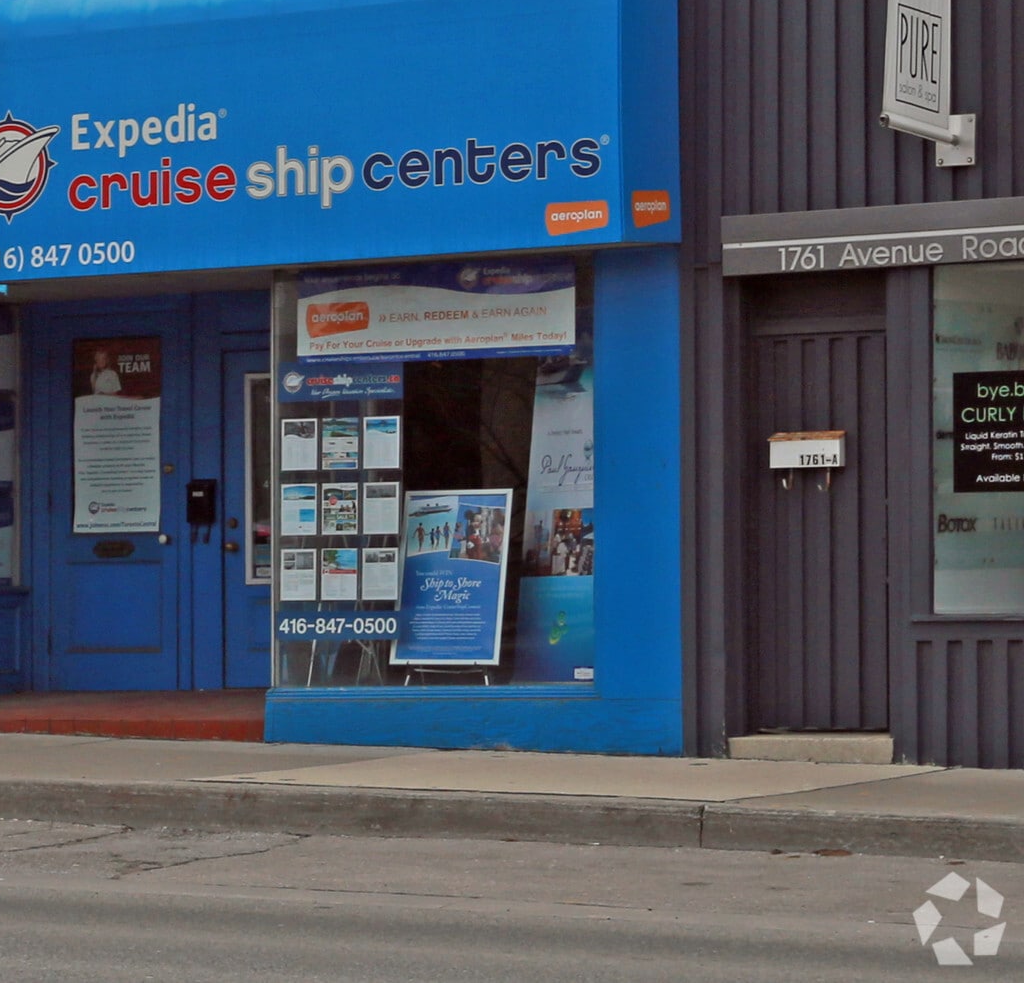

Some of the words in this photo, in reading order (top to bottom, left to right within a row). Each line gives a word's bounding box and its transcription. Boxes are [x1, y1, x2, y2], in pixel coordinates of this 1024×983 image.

[900, 12, 939, 84] PURE
[899, 82, 916, 97] salon
[917, 85, 924, 97] &
[925, 90, 937, 104] spa
[634, 199, 667, 214] aeroplan
[551, 209, 603, 223] aeroplan
[30, 244, 72, 267] 847
[78, 241, 135, 265] 0500
[778, 245, 825, 271] 1761
[838, 242, 944, 267] Avenue
[312, 311, 363, 324] aeroplan
[424, 311, 469, 321] REDEEM
[481, 308, 512, 317] EARN
[514, 306, 546, 316] AGAIN
[310, 342, 325, 352] Pay
[326, 340, 341, 350] For
[343, 340, 363, 349] Your
[365, 338, 392, 348] Cruise
[405, 337, 442, 348] Upgrade
[444, 336, 463, 345] with
[511, 332, 534, 341] Miles
[537, 331, 566, 342] Today!
[118, 361, 151, 373] TEAM
[961, 407, 1016, 423] CURLY
[965, 432, 989, 441] Liquid
[990, 431, 1018, 439] Keratin
[800, 454, 838, 466] 1761-A
[976, 473, 1021, 483] Available
[420, 577, 445, 591] Ship
[445, 580, 454, 588] to
[452, 576, 482, 591] Shore
[434, 589, 471, 604] Magic
[279, 617, 397, 635] 416-847-0500
